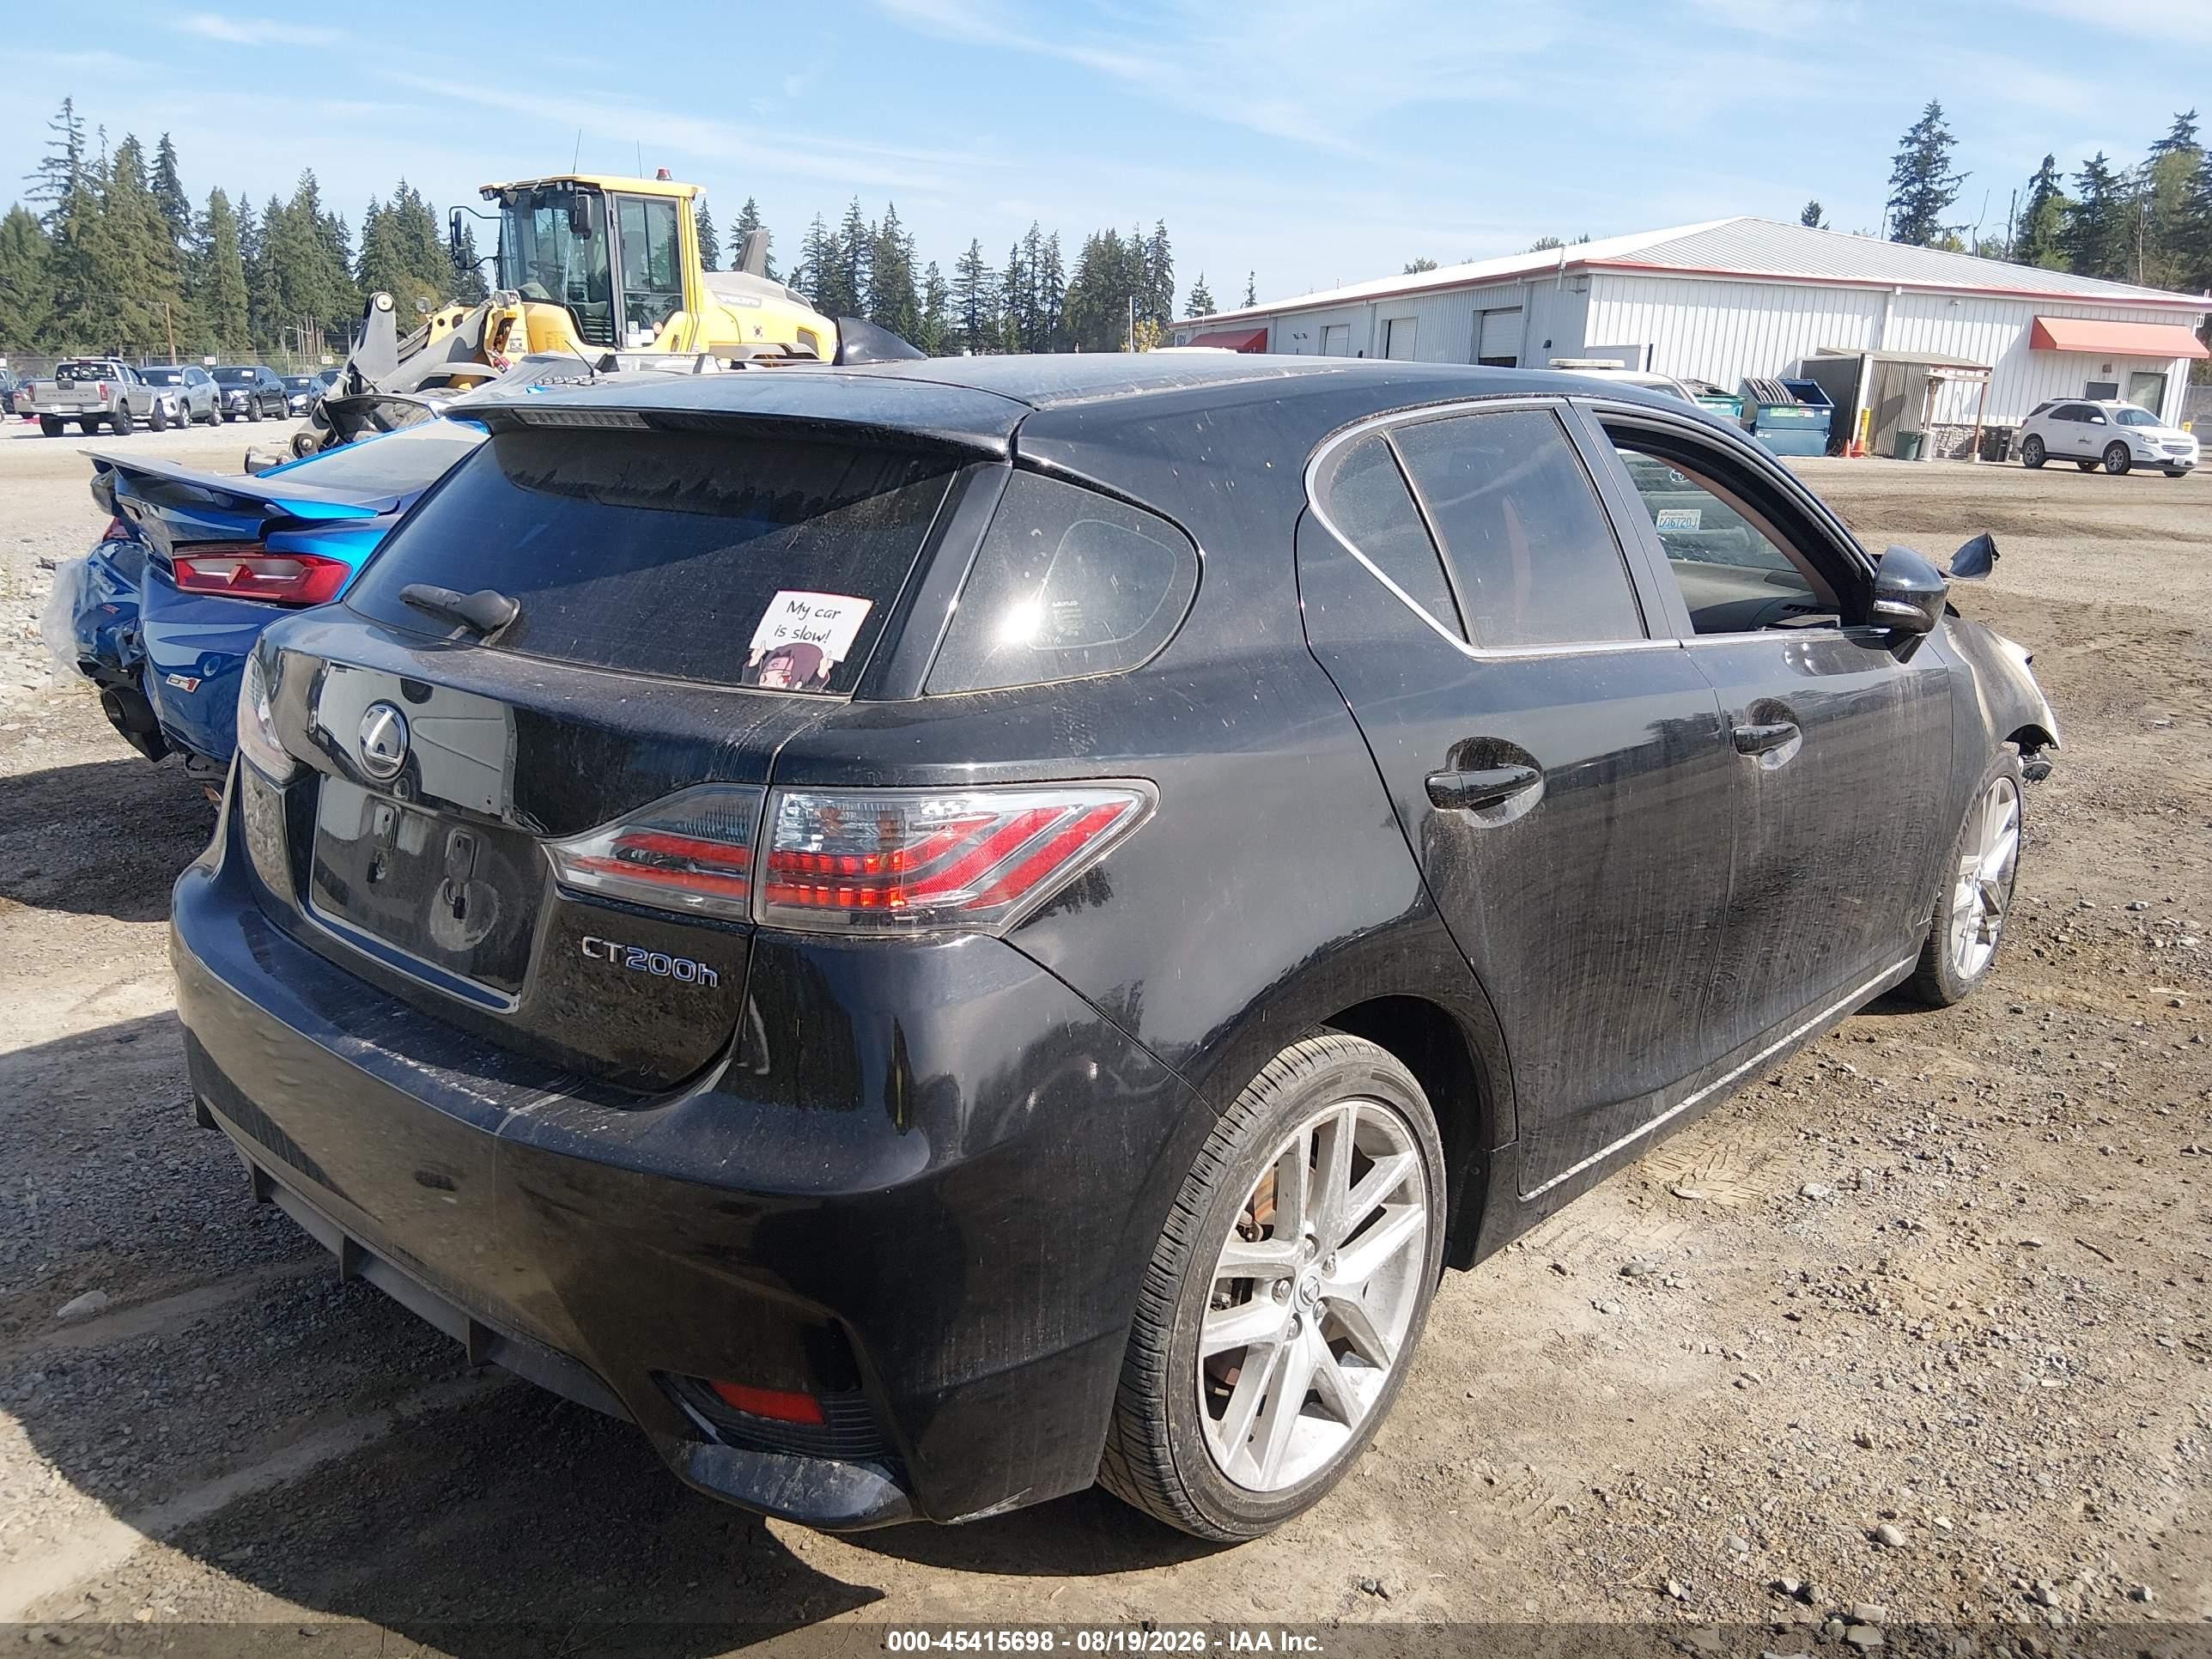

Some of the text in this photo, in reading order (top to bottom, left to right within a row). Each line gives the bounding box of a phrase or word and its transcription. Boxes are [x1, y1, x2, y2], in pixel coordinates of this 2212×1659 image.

[786, 600, 842, 621] My car
[775, 624, 831, 643] is slow!
[581, 936, 719, 988] CT200h
